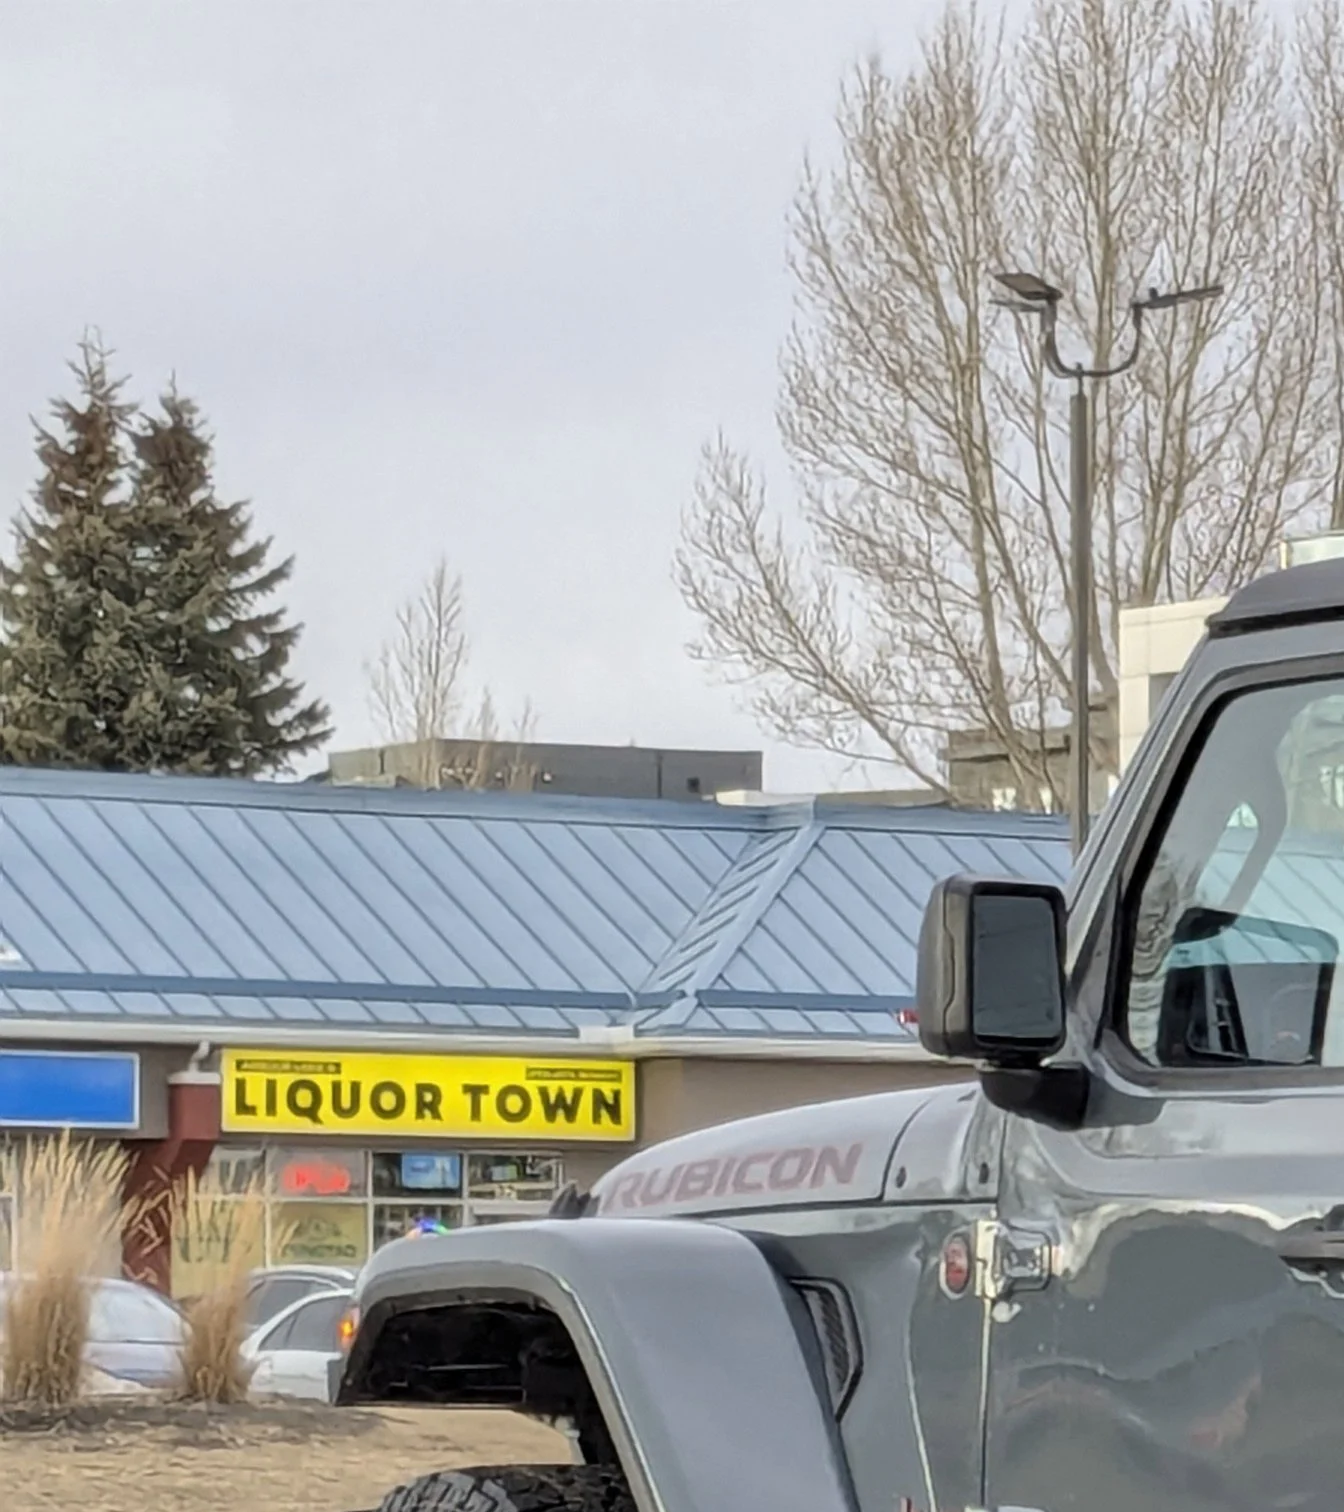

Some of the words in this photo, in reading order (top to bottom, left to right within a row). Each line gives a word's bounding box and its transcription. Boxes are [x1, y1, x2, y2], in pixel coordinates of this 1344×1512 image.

[235, 1077, 443, 1125] LIQUOR
[462, 1083, 623, 1126] TOWN
[605, 1143, 862, 1210] RUBICON
